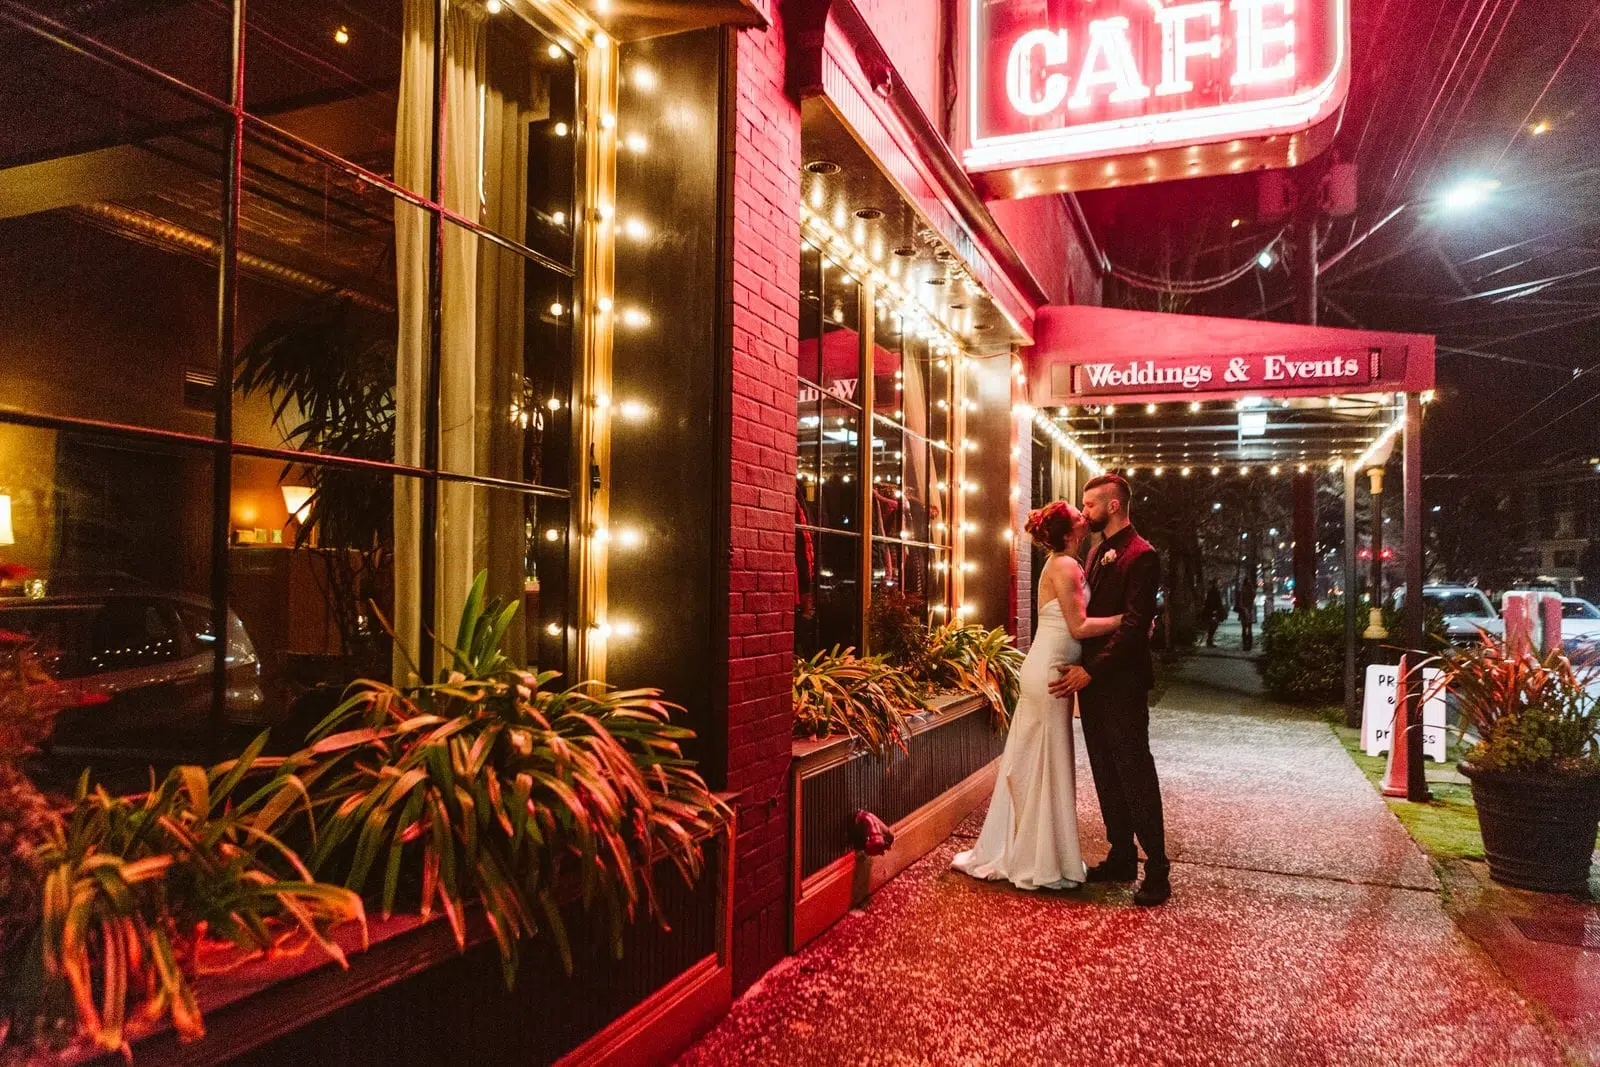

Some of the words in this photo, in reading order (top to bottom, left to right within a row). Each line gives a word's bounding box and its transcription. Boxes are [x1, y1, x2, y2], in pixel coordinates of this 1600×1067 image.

[1005, 0, 1296, 117] CAFE
[1084, 360, 1213, 388] Weddings
[1223, 356, 1250, 382] &
[1263, 354, 1359, 380] Events
